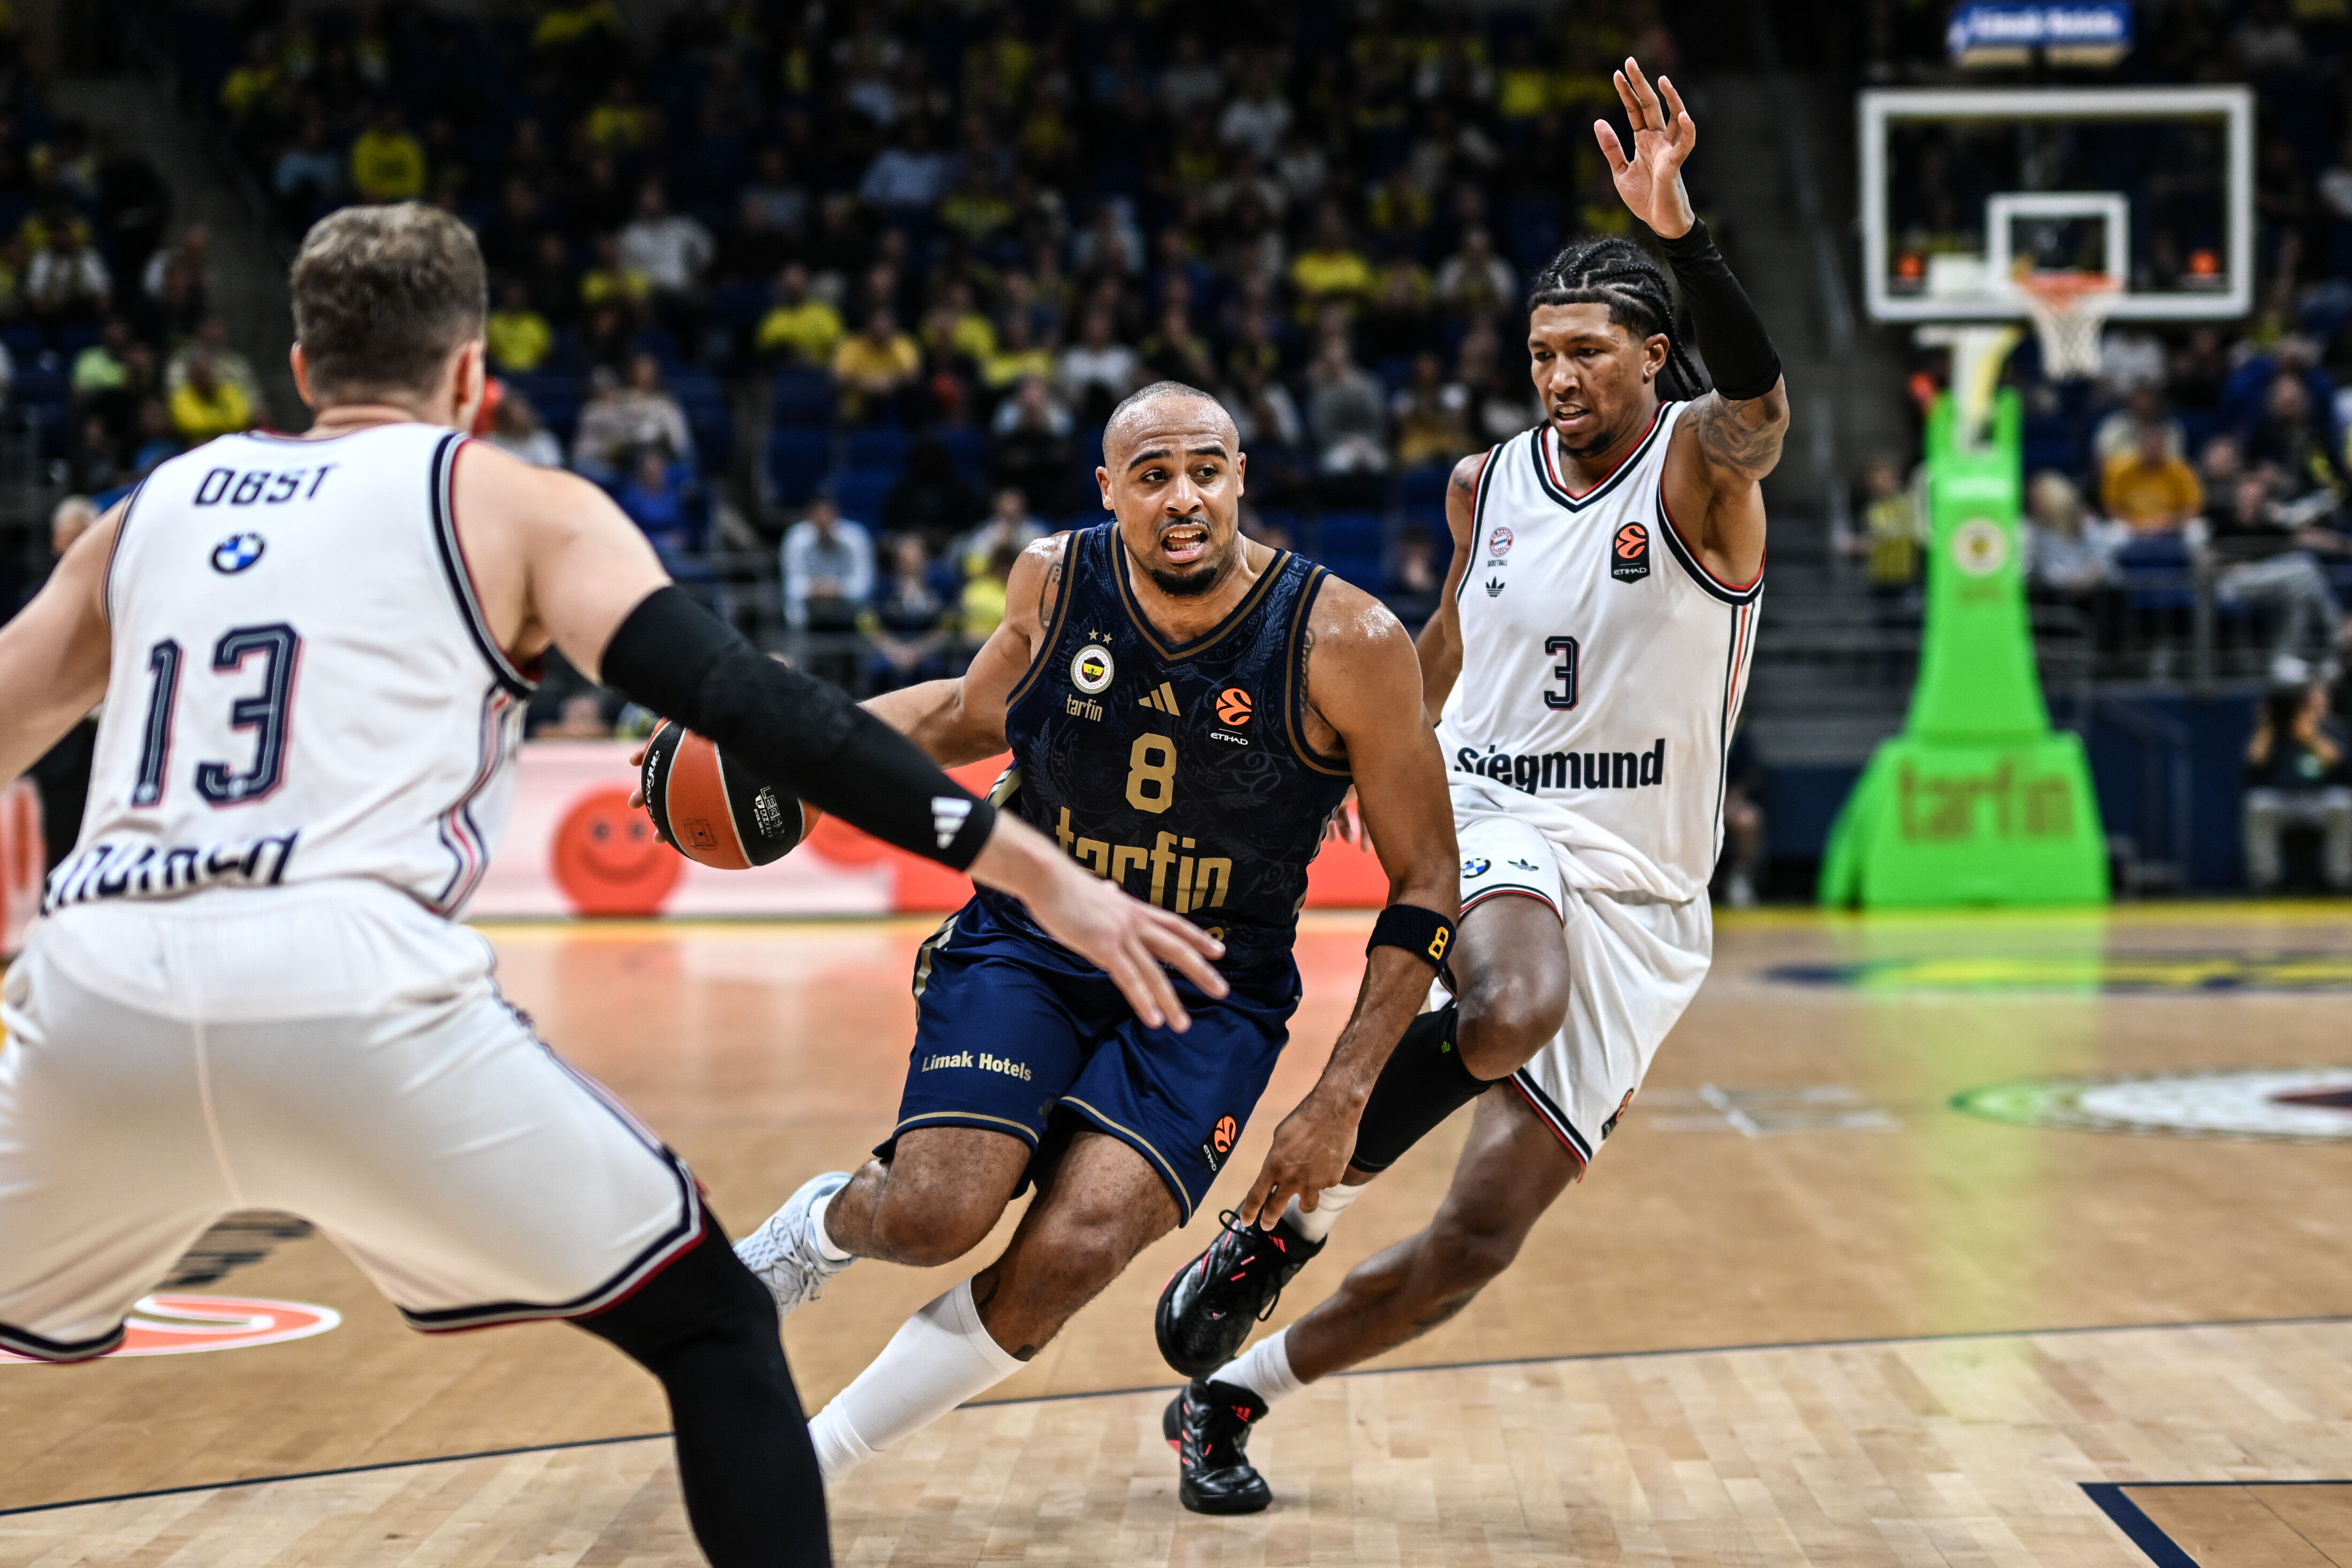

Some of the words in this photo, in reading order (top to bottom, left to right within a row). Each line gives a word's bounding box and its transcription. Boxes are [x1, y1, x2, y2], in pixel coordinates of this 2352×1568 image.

[195, 462, 339, 504] OBST
[1613, 567, 1647, 575] ETIHAD
[1544, 636, 1580, 711] 3
[131, 622, 303, 809] 13
[1066, 693, 1103, 722] tarfin
[1210, 732, 1248, 745] ETIHAD
[1126, 732, 1177, 814] 8
[1454, 738, 1666, 796] Siegmund
[1428, 926, 1449, 960] 8
[921, 1051, 974, 1073] Limak
[979, 1053, 1032, 1081] Hotels
[1203, 1144, 1217, 1171] ETIHAD
